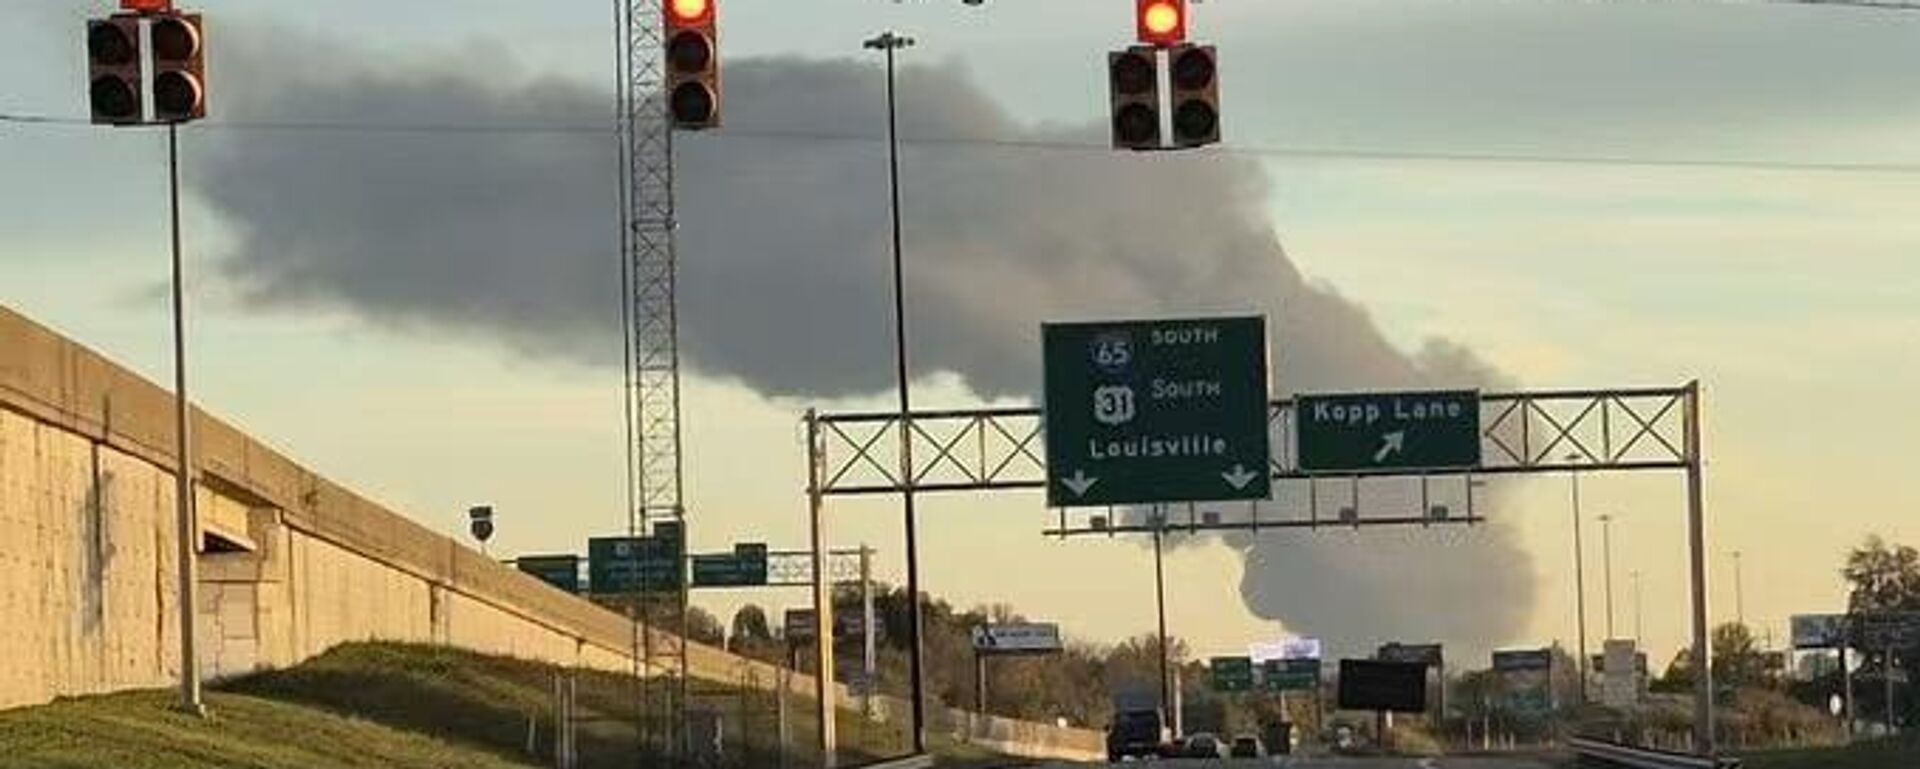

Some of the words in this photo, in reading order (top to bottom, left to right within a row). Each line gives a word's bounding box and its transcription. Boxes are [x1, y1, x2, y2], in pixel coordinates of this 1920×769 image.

[1098, 341, 1130, 364] 65
[1152, 328, 1219, 346] SOUTH
[1102, 392, 1128, 416] 31
[1152, 379, 1222, 399] SOUTH
[1313, 399, 1380, 424] Kopp
[1395, 398, 1462, 420] Lane
[1090, 435, 1226, 458] Louisville
